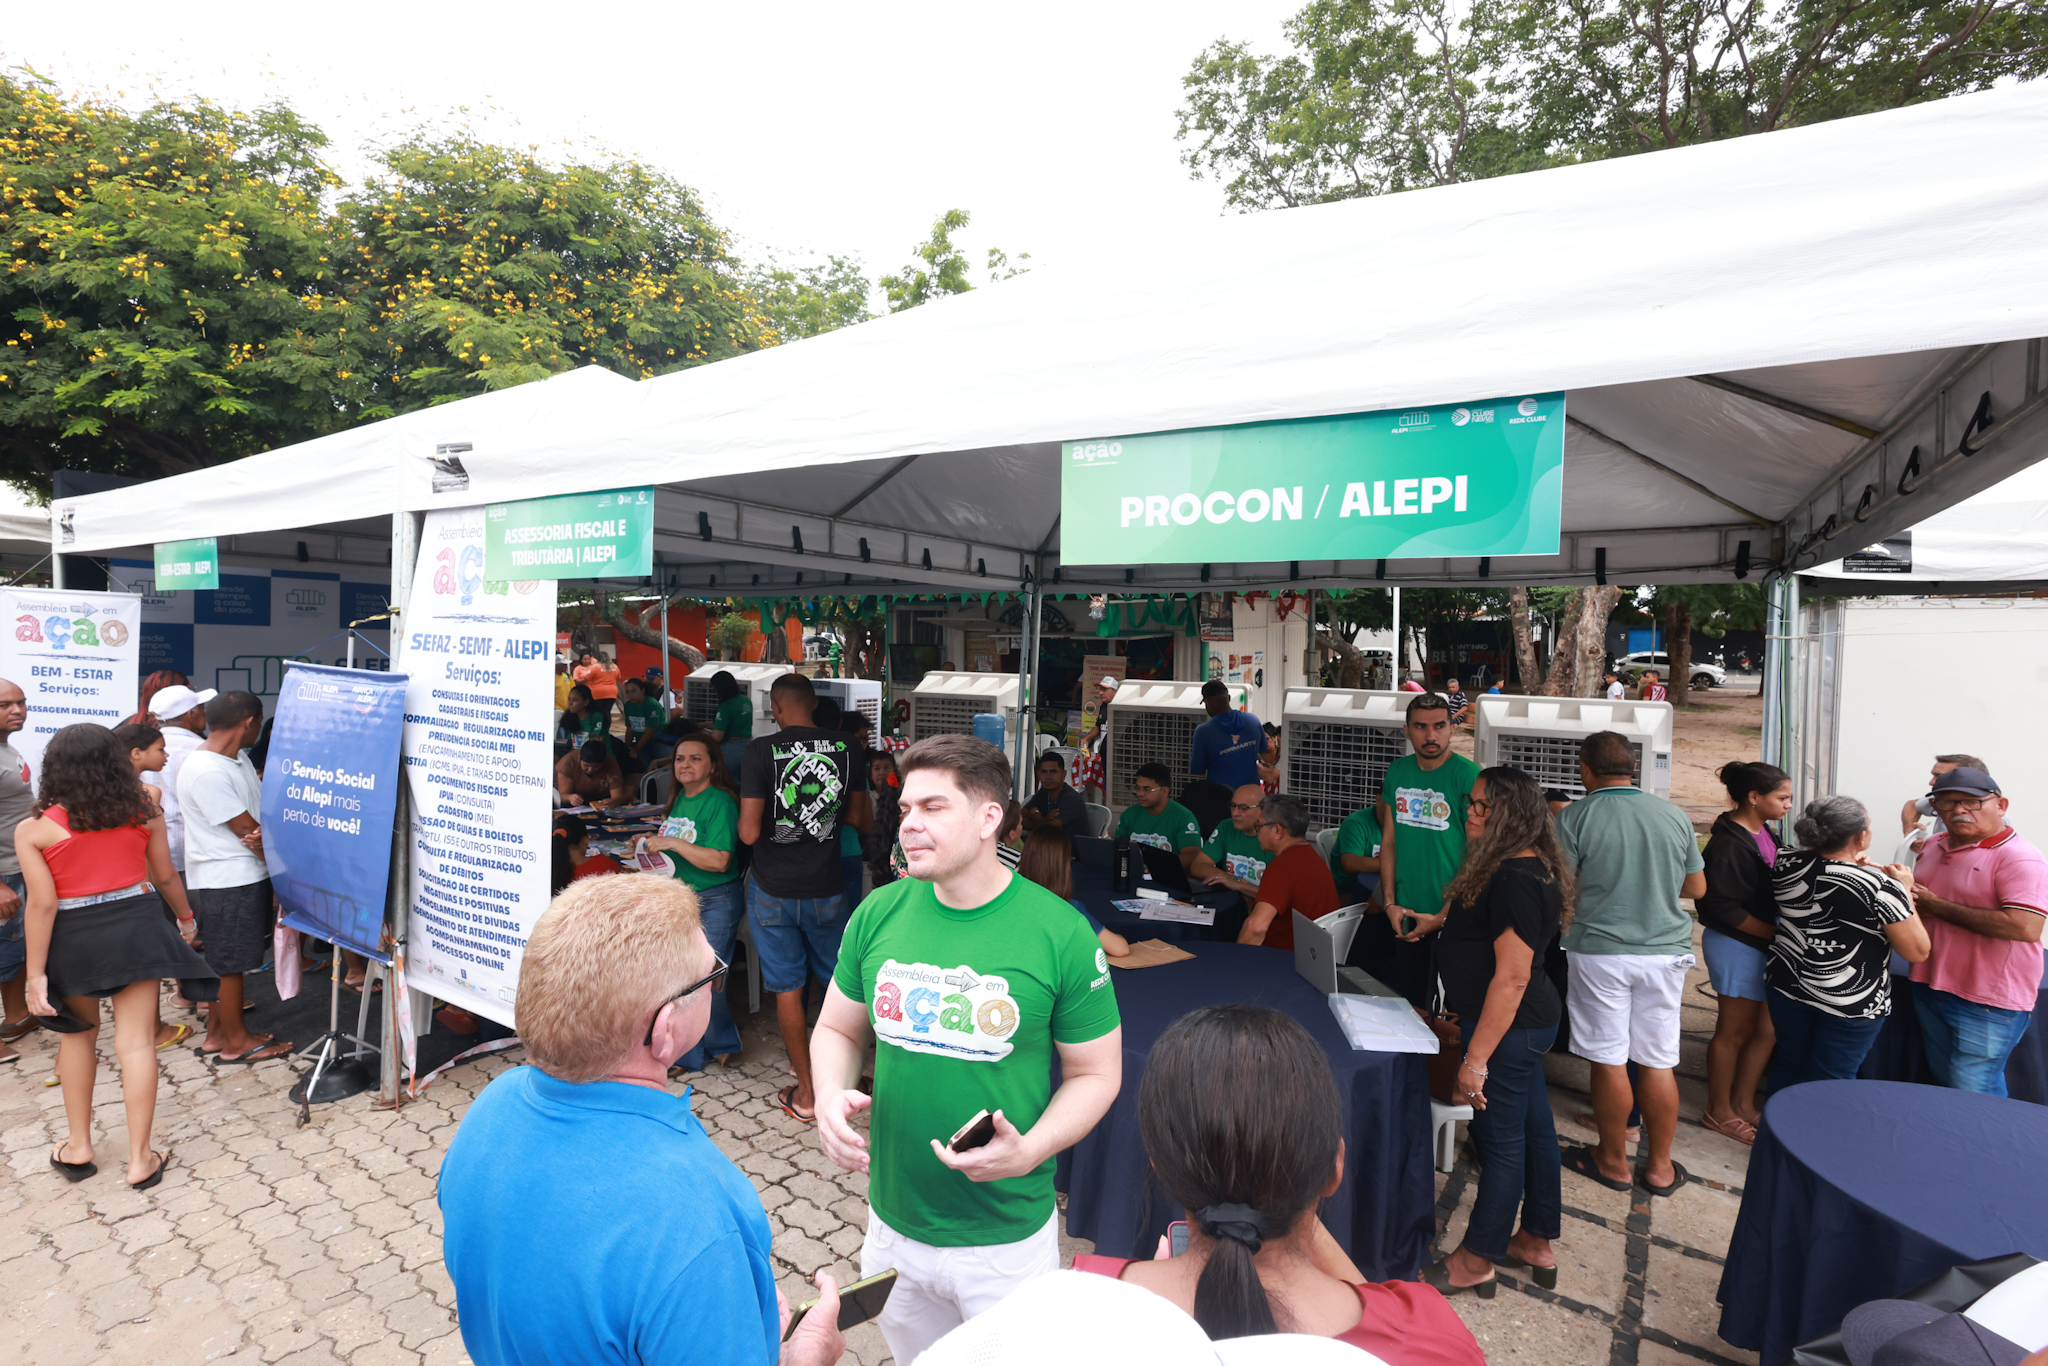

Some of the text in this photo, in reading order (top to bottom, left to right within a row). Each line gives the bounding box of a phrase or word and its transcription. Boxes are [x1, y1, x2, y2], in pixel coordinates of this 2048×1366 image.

[1120, 485, 1303, 528] PROCON
[1339, 475, 1469, 518] ALEPI
[438, 523, 483, 540] Assembleia
[504, 518, 627, 544] ASSESSORIA FISCAL E
[511, 545, 574, 566] TRIBUTÁRIA
[583, 545, 617, 562] ALEPI
[160, 562, 192, 576] BEM-ESTAR
[194, 560, 212, 574] ALEPI
[213, 592, 253, 601] sempre,
[16, 602, 118, 615] Assembleia em
[214, 605, 253, 615] do povo
[140, 634, 165, 642] esde
[410, 633, 452, 653] SEFAZ
[459, 636, 493, 656] SEMF
[503, 639, 549, 661] ALEPI
[31, 666, 62, 677] BEM
[73, 668, 113, 680] ESTAR
[445, 661, 502, 687] Serviços:
[39, 682, 100, 697] Serviços:
[432, 689, 464, 702] CONSULTAS
[464, 693, 469, 702] E
[27, 705, 120, 717] ASSAGEM RELAXANTE
[438, 704, 509, 722] CADASTRAIS E FISCAIS
[471, 738, 498, 751] SOCIAL
[499, 742, 516, 753] MEI
[527, 731, 545, 742] MEI
[814, 745, 836, 753] SHARK
[485, 755, 490, 765] E
[491, 756, 521, 771] APOIO)
[281, 758, 375, 790] O Serviço Social
[466, 766, 471, 774] E
[471, 768, 494, 780] TAXAS
[495, 771, 508, 782] DO
[509, 774, 546, 789] DETRAN)
[427, 773, 509, 797] DOCUMENTOS FISCAIS
[286, 783, 361, 812] da Alepi mais
[439, 789, 495, 811] IPVA (CONSULTA)
[283, 808, 362, 835] perto de você!
[437, 804, 494, 826] CADASTRO (MEI)
[819, 799, 843, 825] SOUND
[447, 820, 456, 831] DE
[456, 823, 477, 836] GUIAS
[479, 828, 483, 837] E
[485, 829, 524, 844] BOLETOS
[448, 850, 453, 859] E
[460, 839, 492, 853] OUTROS
[493, 845, 537, 863] TRIBUTOS)
[439, 863, 450, 873] DE
[458, 882, 469, 893] DE
[419, 894, 471, 921] PARCELAMENTO
[472, 913, 483, 924] DE
[423, 884, 511, 916] NEGATIVAS E POSITIVAS
[413, 904, 457, 930] AGENDAMENTO
[457, 924, 468, 934] DE
[425, 924, 511, 959] ACOMPANHAMENTO DE
[432, 939, 505, 971] PROCESSOS ONLINE
[880, 965, 1004, 992] Assembleia em
[1090, 975, 1105, 988] REDE
